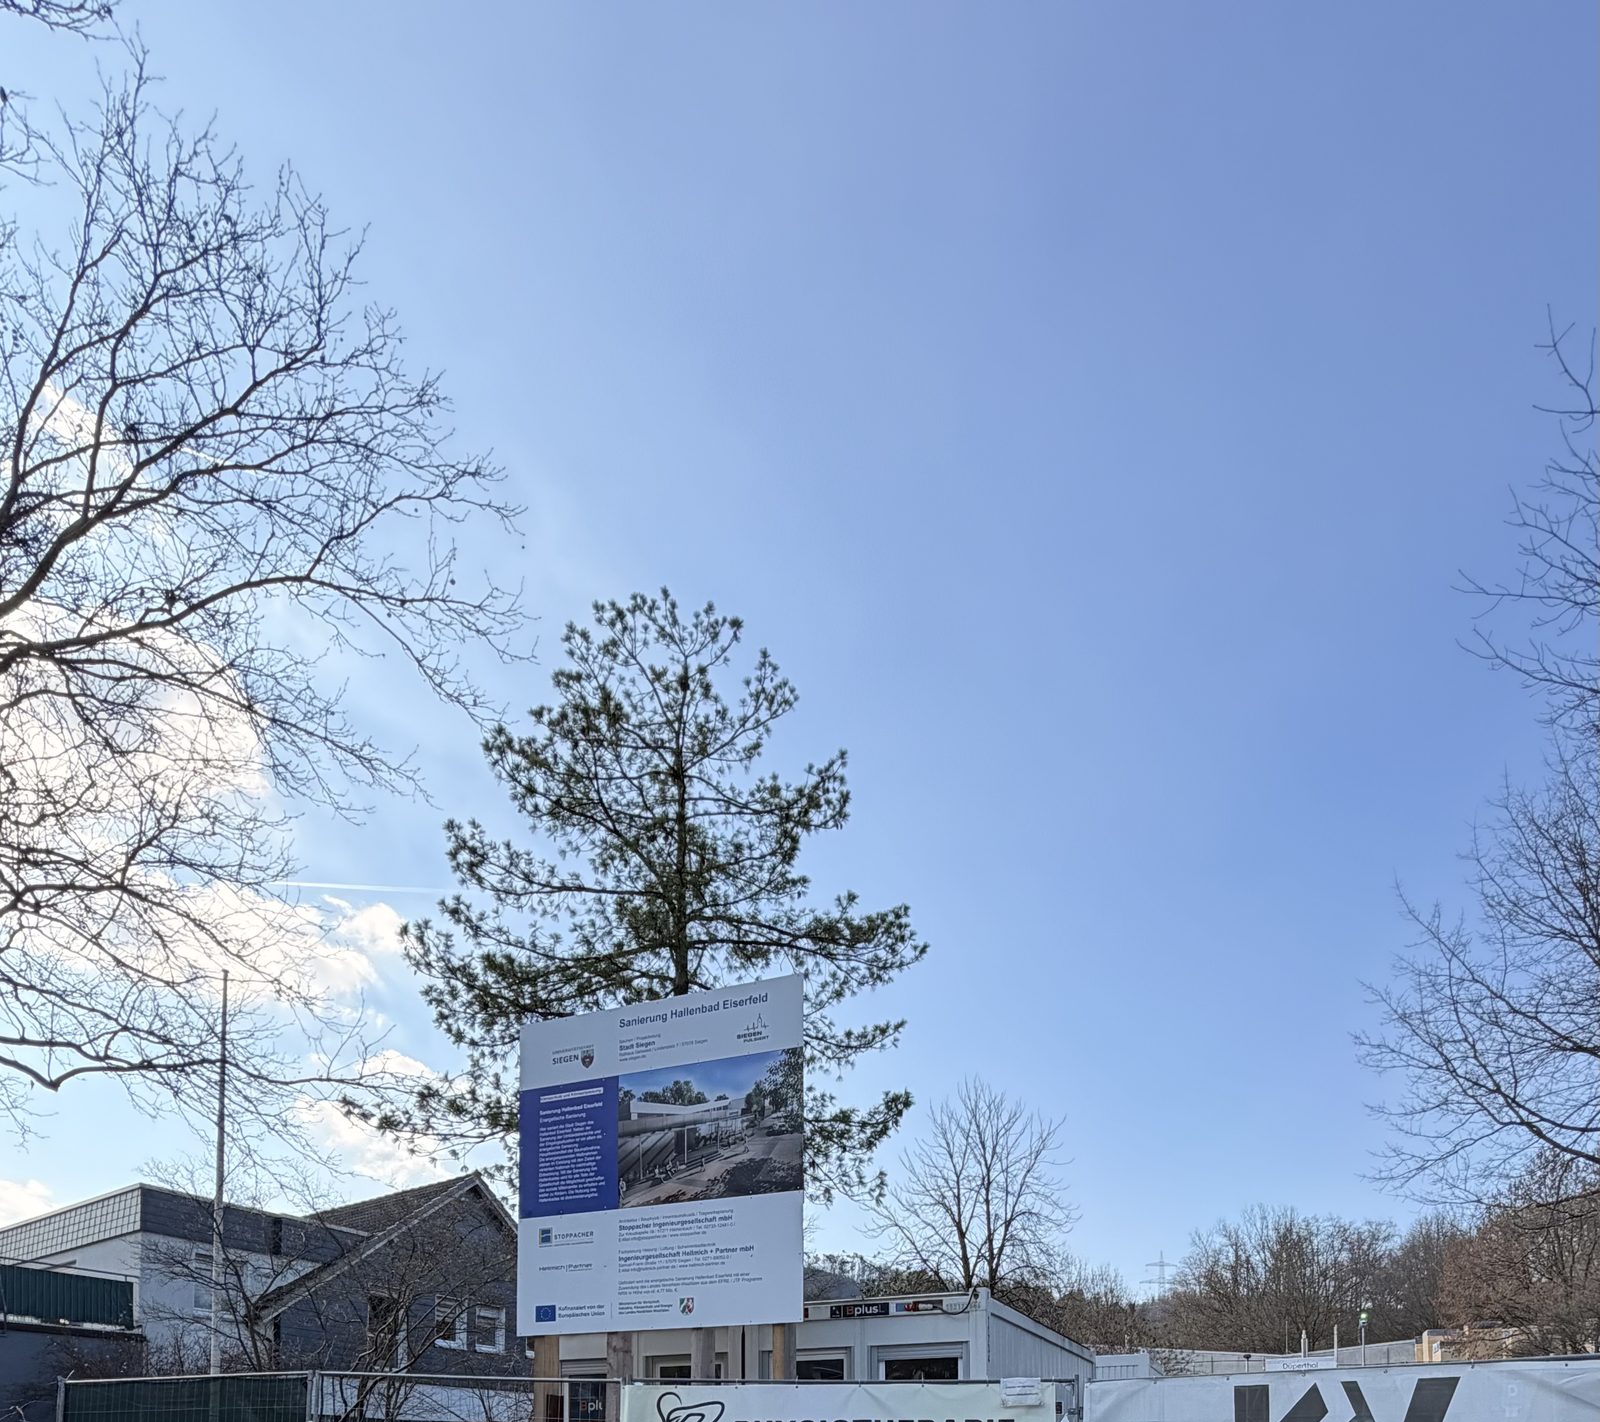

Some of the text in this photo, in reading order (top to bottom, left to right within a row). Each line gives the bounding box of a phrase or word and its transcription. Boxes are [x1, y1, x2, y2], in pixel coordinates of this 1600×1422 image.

[618, 993, 769, 1029] Sanierung Hallenbad Eiserfeld
[619, 1042, 635, 1051] Stadt
[635, 1040, 656, 1051] Siegen
[552, 1054, 579, 1065] SIEGEN
[619, 1221, 652, 1232] Stoppacher
[652, 1215, 717, 1229] Ingenieurgesellschaft
[554, 1231, 594, 1240] STOPPACHER
[618, 1251, 681, 1263] Ingenieurgesellschaft
[715, 1246, 738, 1254] Partner
